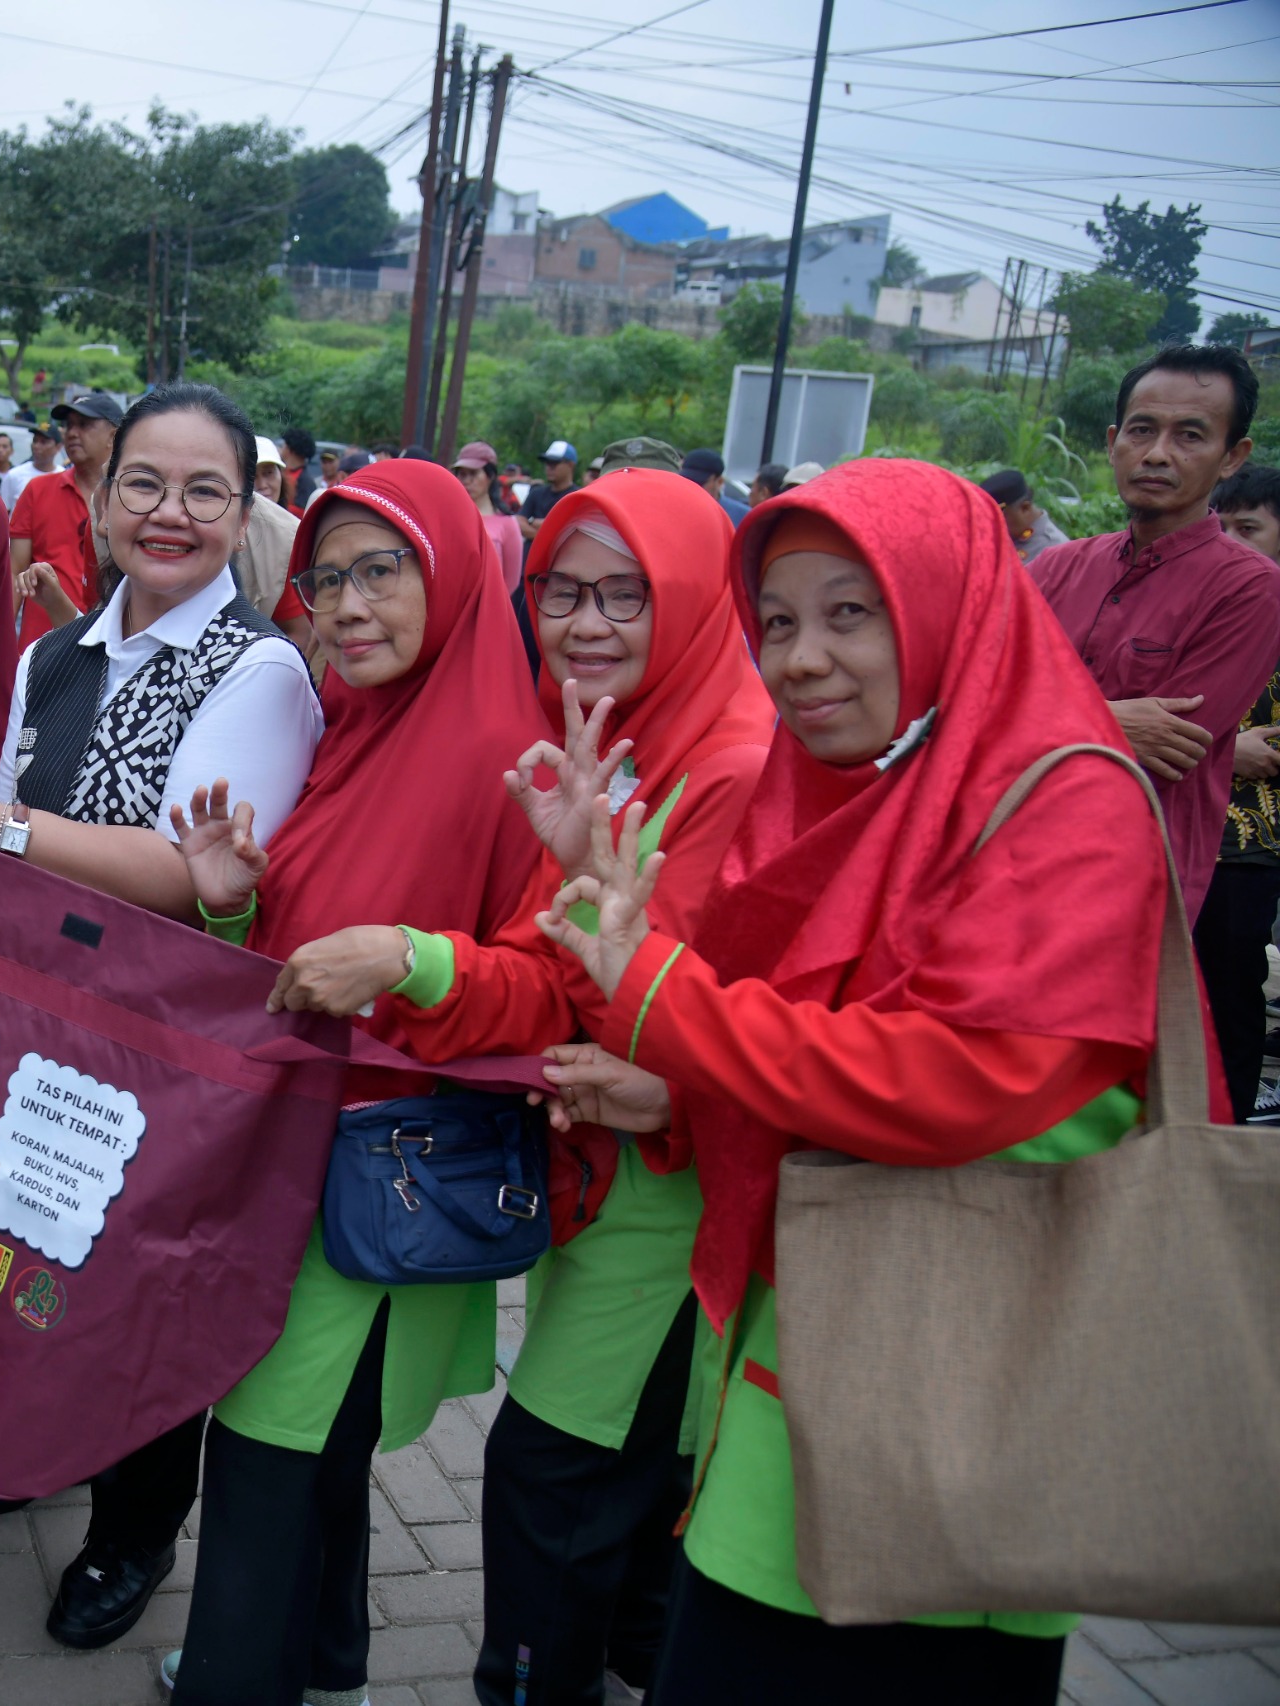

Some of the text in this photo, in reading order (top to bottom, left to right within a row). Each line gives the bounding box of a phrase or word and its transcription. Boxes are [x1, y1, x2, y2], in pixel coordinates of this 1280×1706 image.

[20, 1095, 67, 1126] UNTUK
[68, 1116, 122, 1150] TEMPAT
[36, 1078, 124, 1127] TAS PILAH INI
[11, 1130, 105, 1184] KORAN, MAJALAH,
[23, 1155, 80, 1192] BUKU, HVS,
[9, 1169, 81, 1212] KARDUS, DAN
[16, 1192, 60, 1222] KARTON
